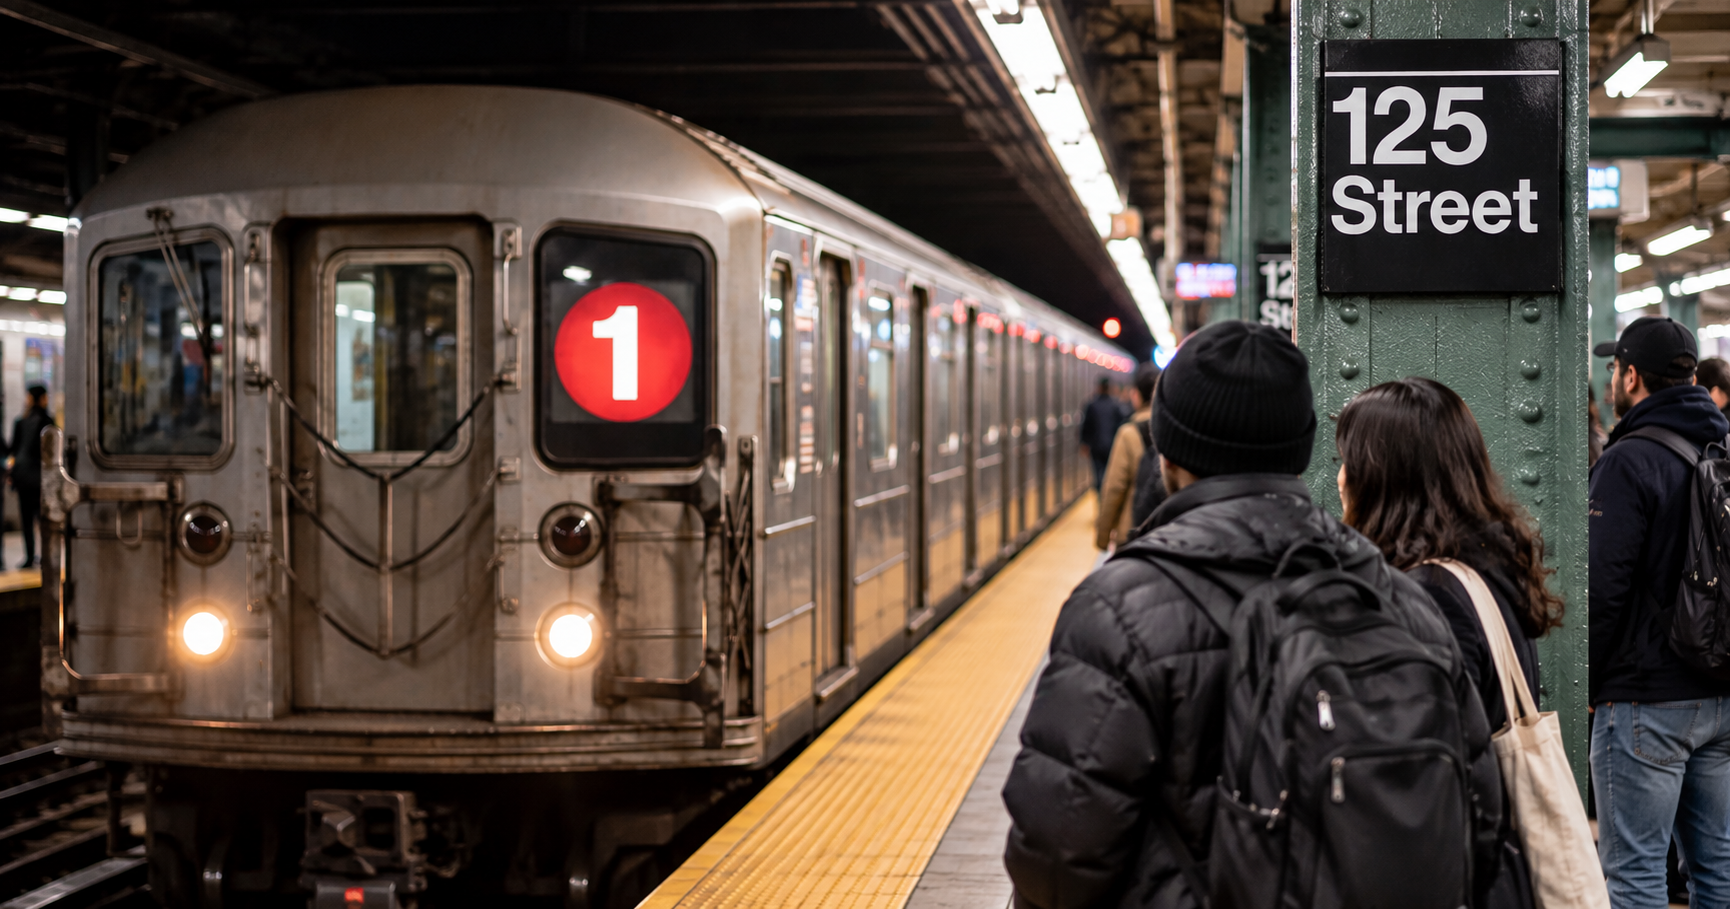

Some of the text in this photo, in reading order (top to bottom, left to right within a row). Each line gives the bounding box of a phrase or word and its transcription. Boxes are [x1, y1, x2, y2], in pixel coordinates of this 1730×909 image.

[1333, 85, 1488, 166] 125
[1331, 175, 1538, 235] Street
[592, 305, 639, 401] 1
